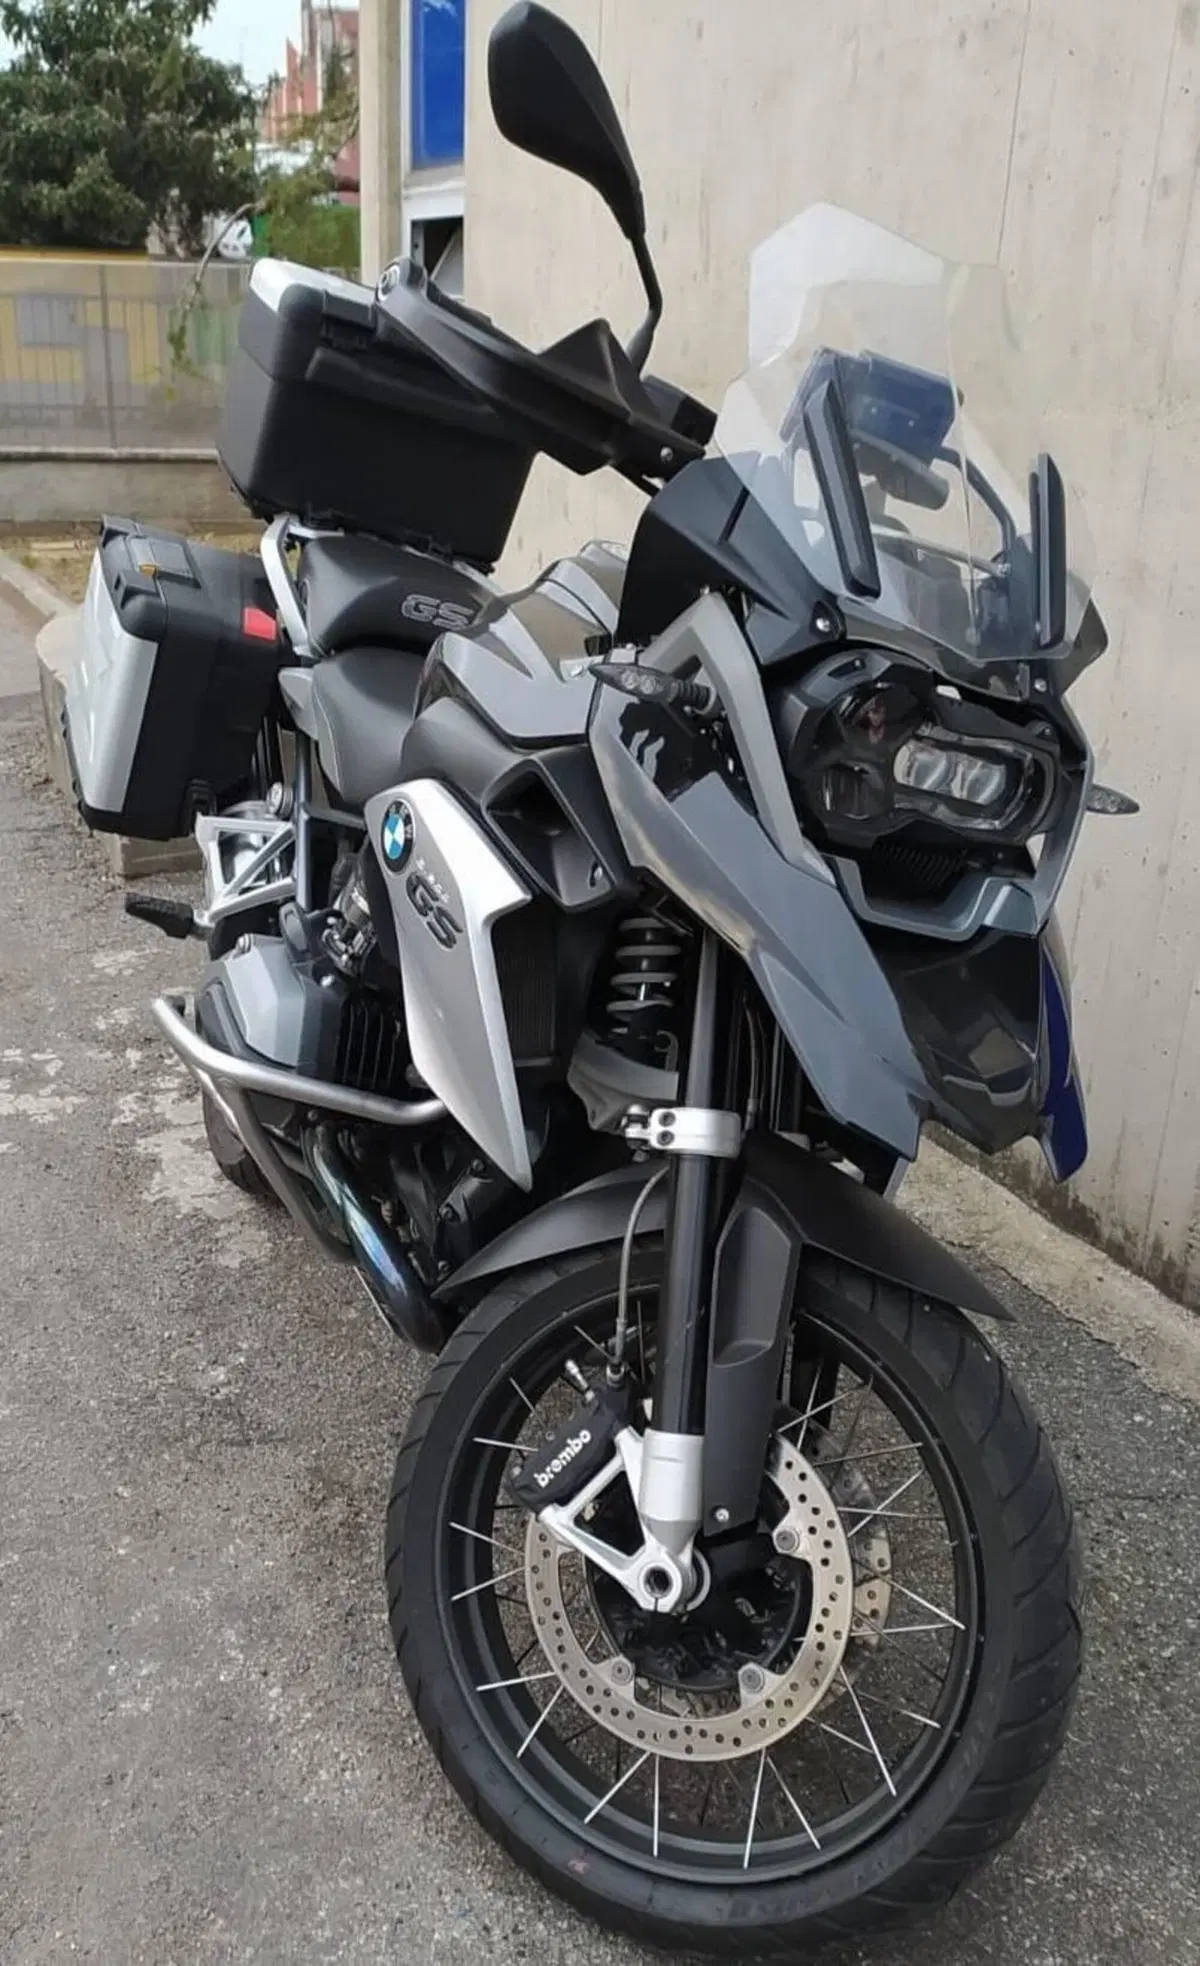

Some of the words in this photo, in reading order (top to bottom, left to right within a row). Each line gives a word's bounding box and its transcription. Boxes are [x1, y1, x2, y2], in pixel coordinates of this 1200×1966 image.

[401, 594, 475, 632] GS
[406, 872, 463, 949] GS
[533, 1430, 591, 1488] brembo
